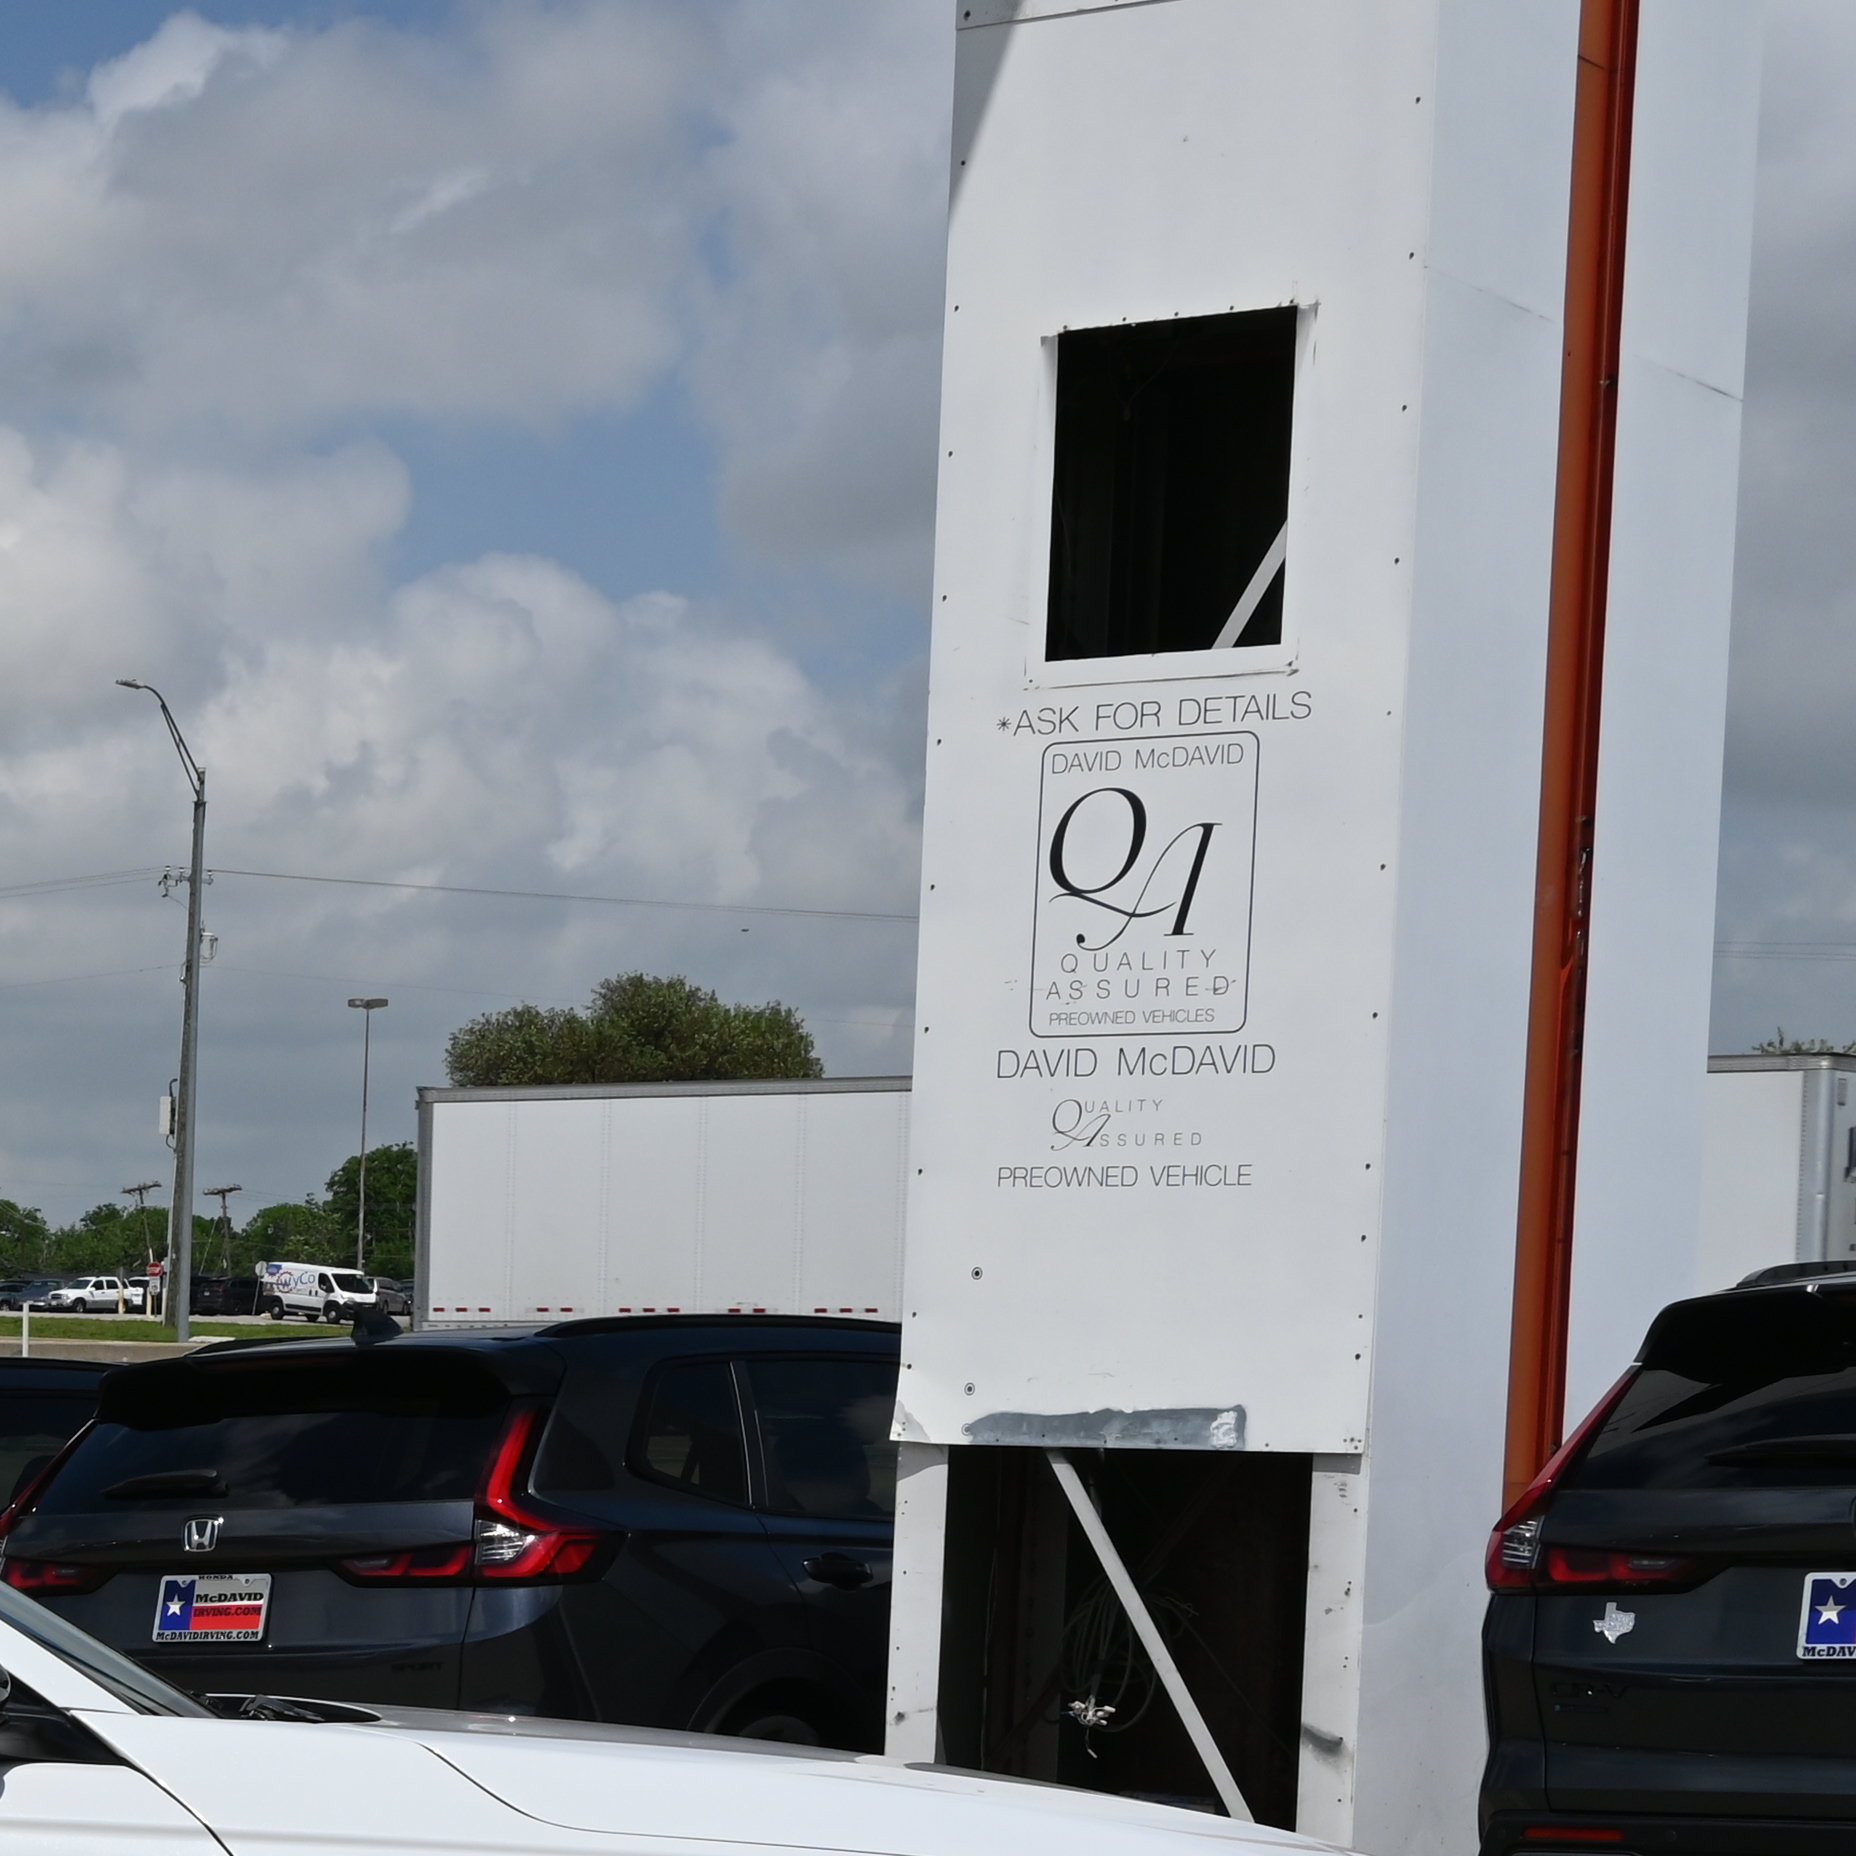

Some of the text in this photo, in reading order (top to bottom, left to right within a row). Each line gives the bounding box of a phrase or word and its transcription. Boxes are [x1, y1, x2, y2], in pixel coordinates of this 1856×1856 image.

[1095, 701, 1162, 731] FOR
[1178, 691, 1313, 726] DETAILS
[1051, 743, 1244, 774] DAVID McDAVID
[1060, 949, 1217, 974] QUALITY
[1046, 975, 1230, 1001] ASSURED
[1049, 1008, 1215, 1026] PREOWNED VEHICLES
[997, 1043, 1276, 1079] DAVID McDAVID
[997, 1163, 1253, 1188] PREOWNED VEHICLE
[195, 1592, 264, 1603] McDAVID
[193, 1606, 262, 1617] IRVING.COM
[155, 1630, 259, 1641] McDAVIDIRVING.COM
